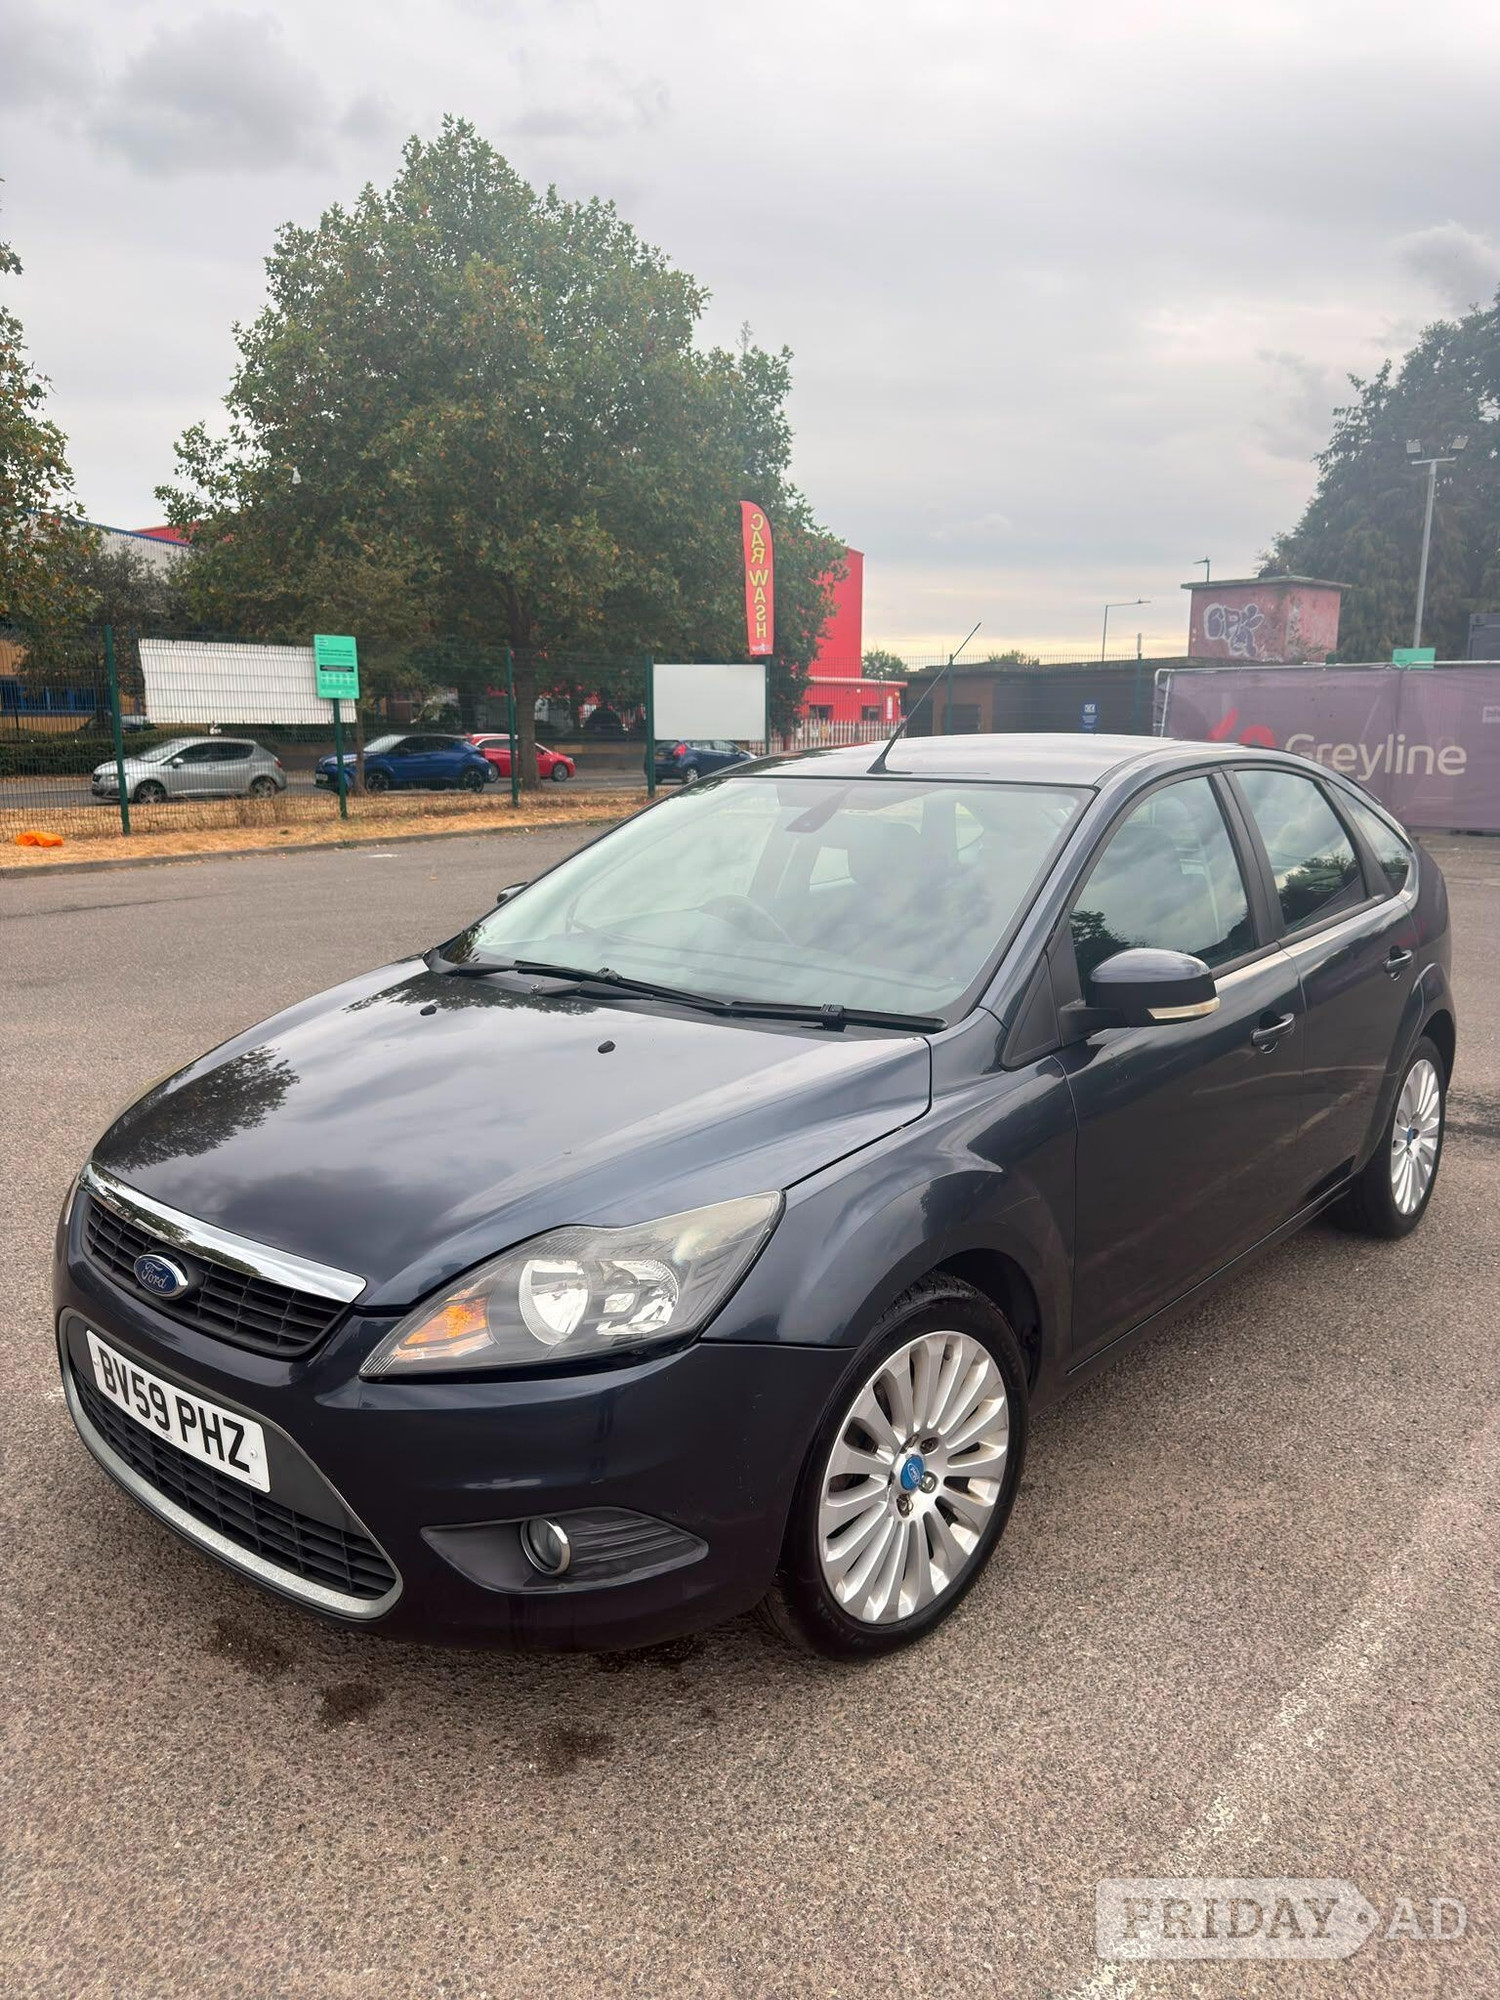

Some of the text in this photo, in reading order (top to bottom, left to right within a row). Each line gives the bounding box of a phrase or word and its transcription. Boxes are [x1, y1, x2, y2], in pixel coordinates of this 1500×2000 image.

[141, 1262, 169, 1288] Ford
[98, 1346, 250, 1473] BV59 PHZ
